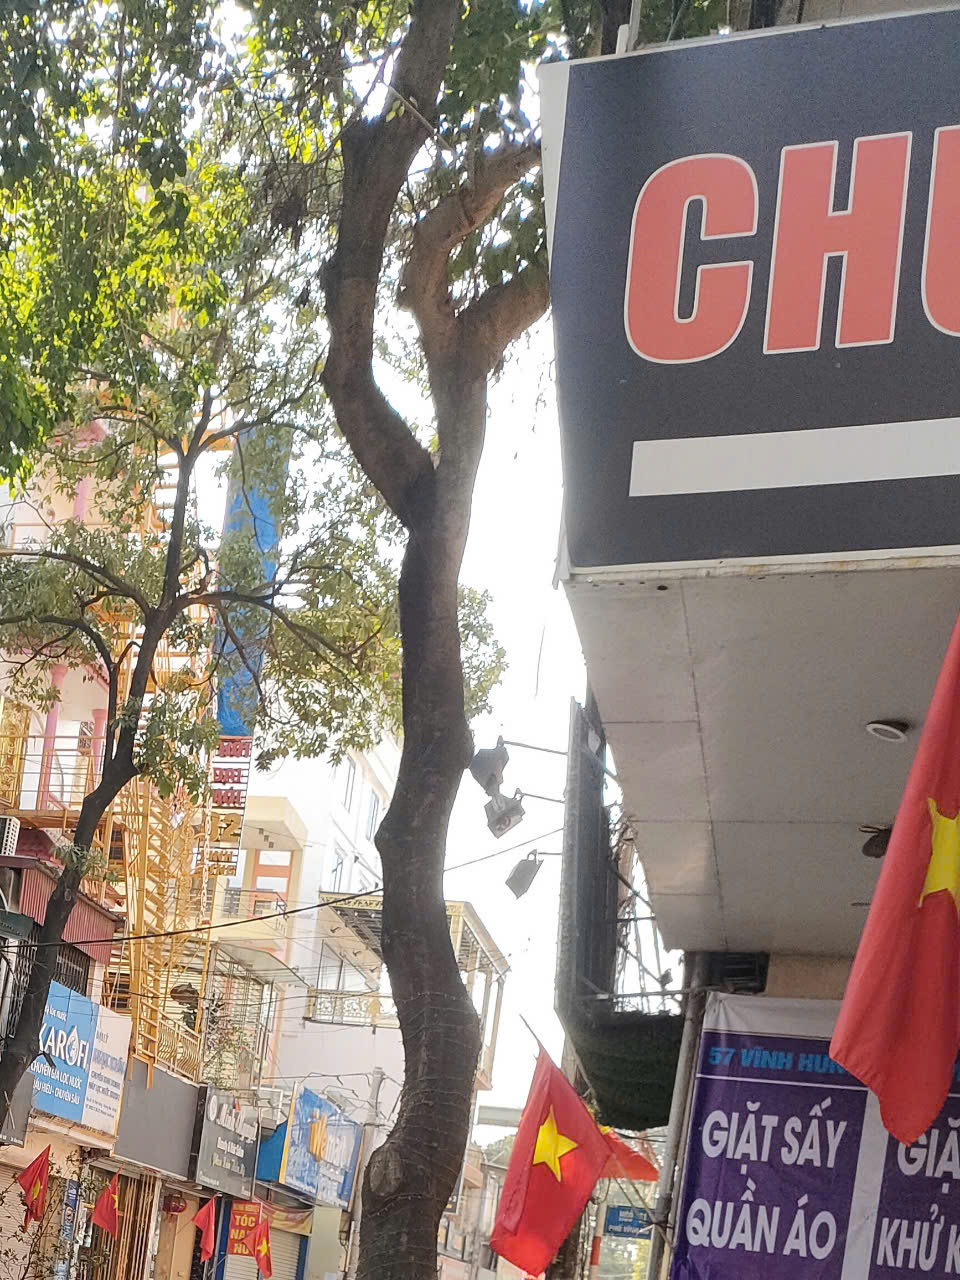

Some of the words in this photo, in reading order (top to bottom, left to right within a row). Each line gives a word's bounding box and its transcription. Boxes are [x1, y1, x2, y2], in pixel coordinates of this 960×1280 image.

[624, 125, 960, 364] CH
[708, 1046, 736, 1066] 57
[741, 1046, 793, 1070] VĨNH
[702, 1101, 778, 1175] GIẶT
[781, 1097, 847, 1168] SẤY
[234, 1214, 256, 1227] TÓC
[686, 1178, 780, 1253] QUẦN
[783, 1194, 837, 1260] ÁO
[877, 1203, 944, 1271] KHỬ
